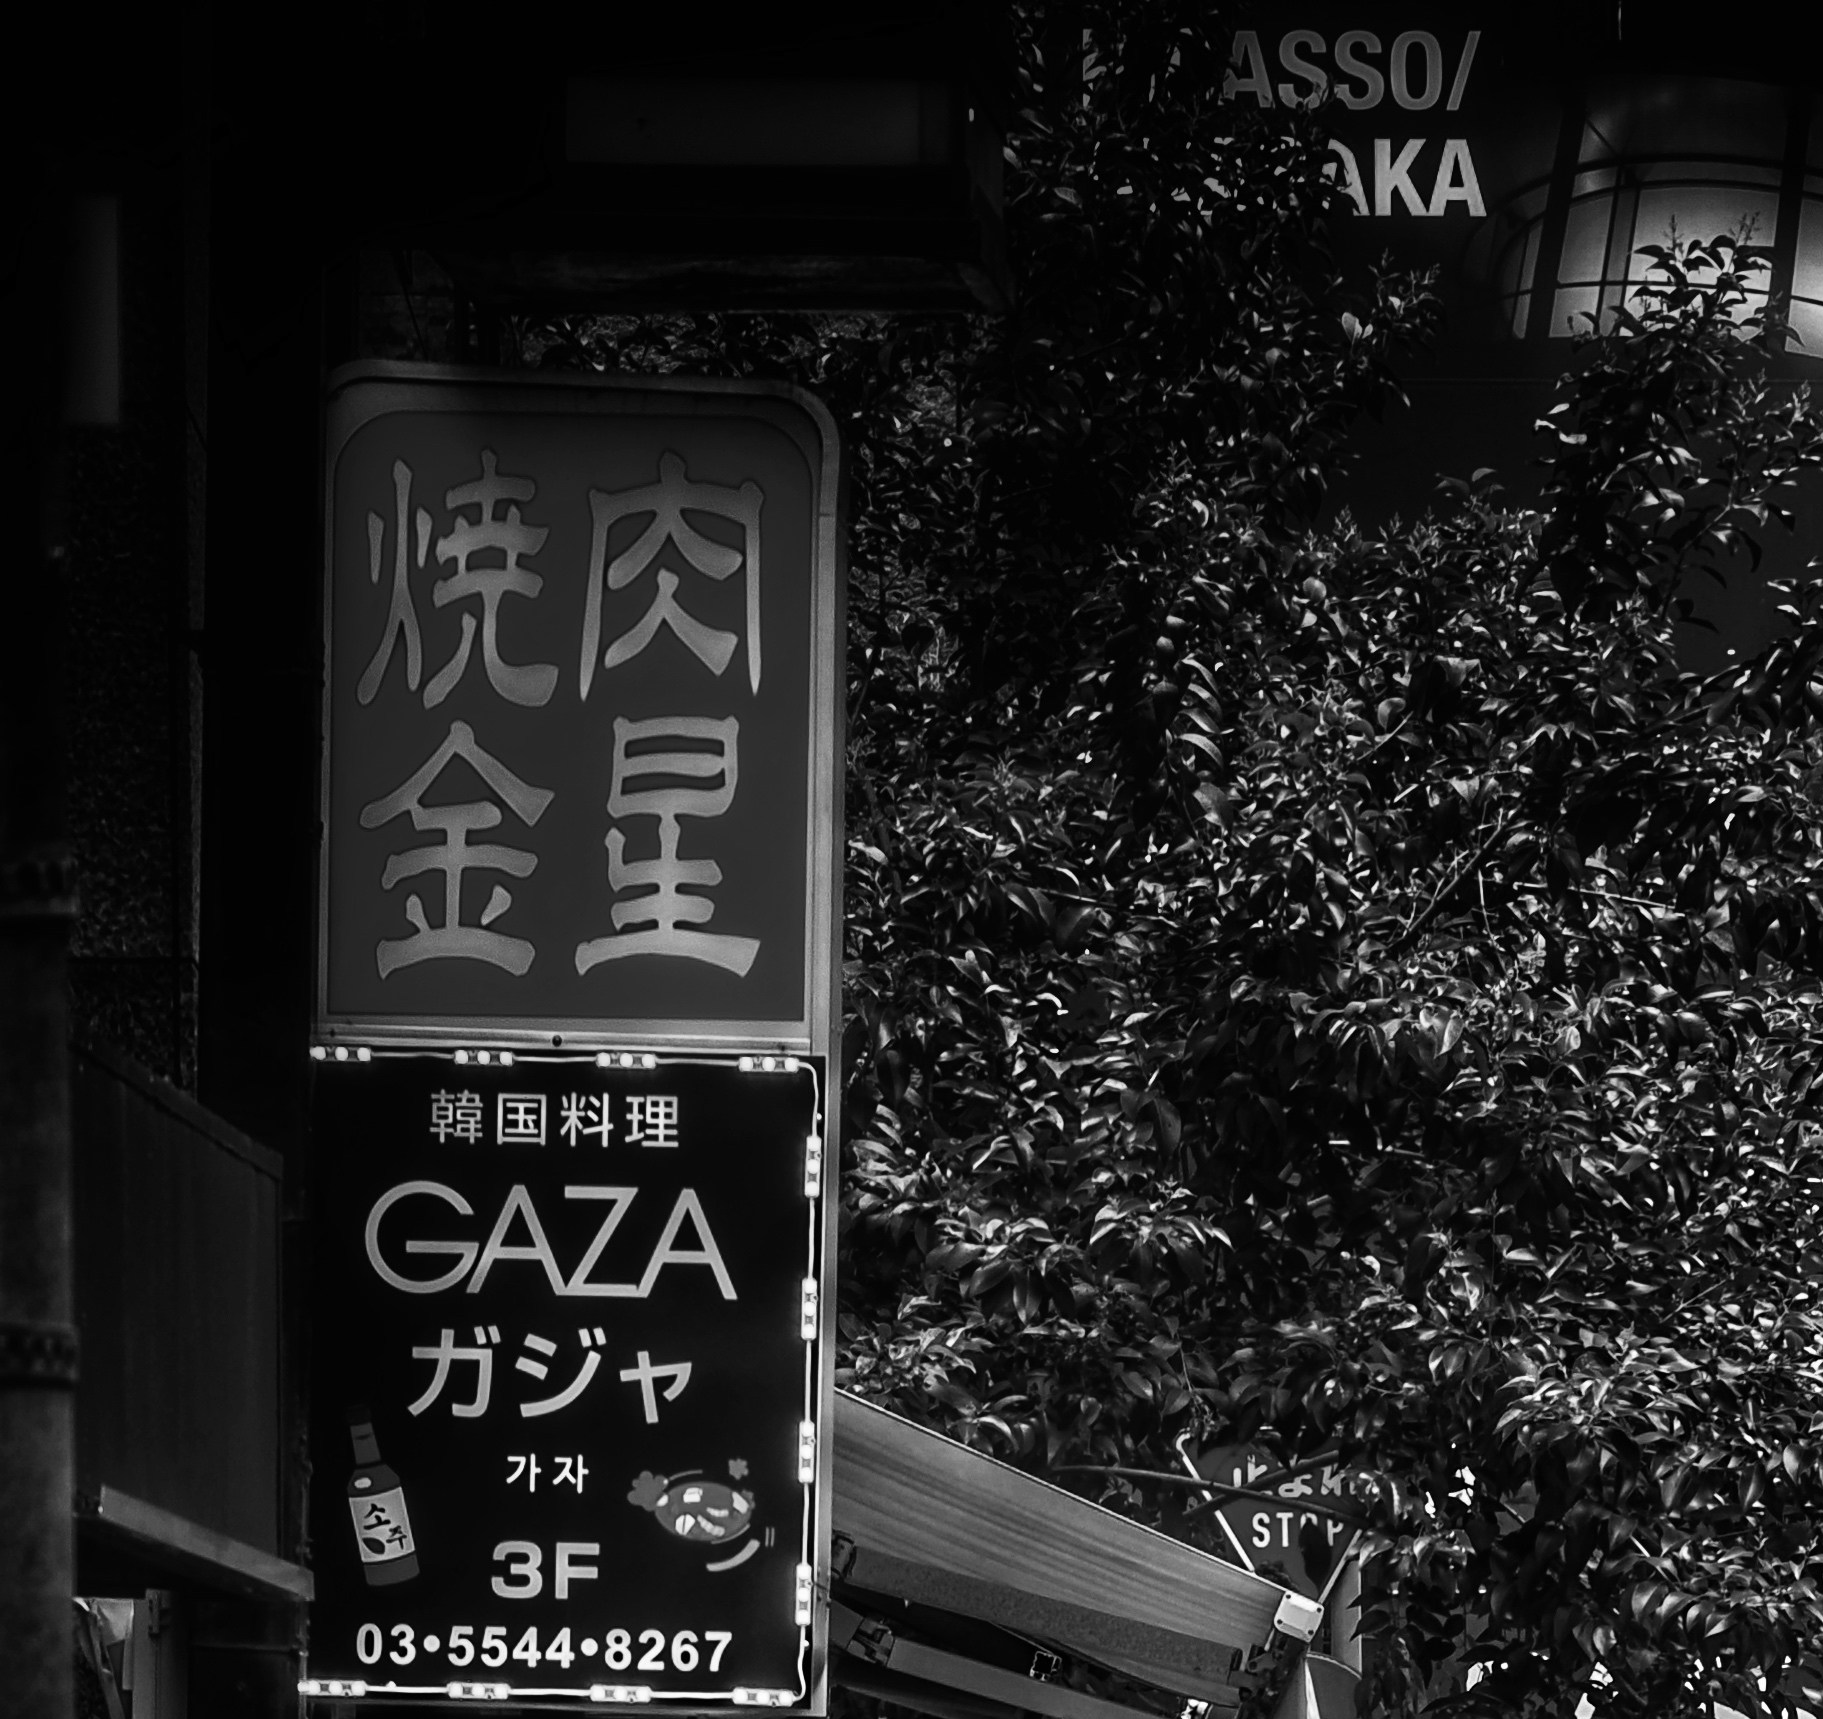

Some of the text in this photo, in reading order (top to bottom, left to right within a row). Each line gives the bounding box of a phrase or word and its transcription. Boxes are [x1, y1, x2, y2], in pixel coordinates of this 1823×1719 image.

[357, 449, 764, 709] 焼肉
[359, 716, 761, 979] 金星
[429, 1090, 680, 1149] 韓国料理
[364, 1180, 738, 1300] GAZA
[407, 1325, 692, 1424] ガジャ
[506, 1453, 589, 1494] 가자
[490, 1540, 601, 1600] 3F
